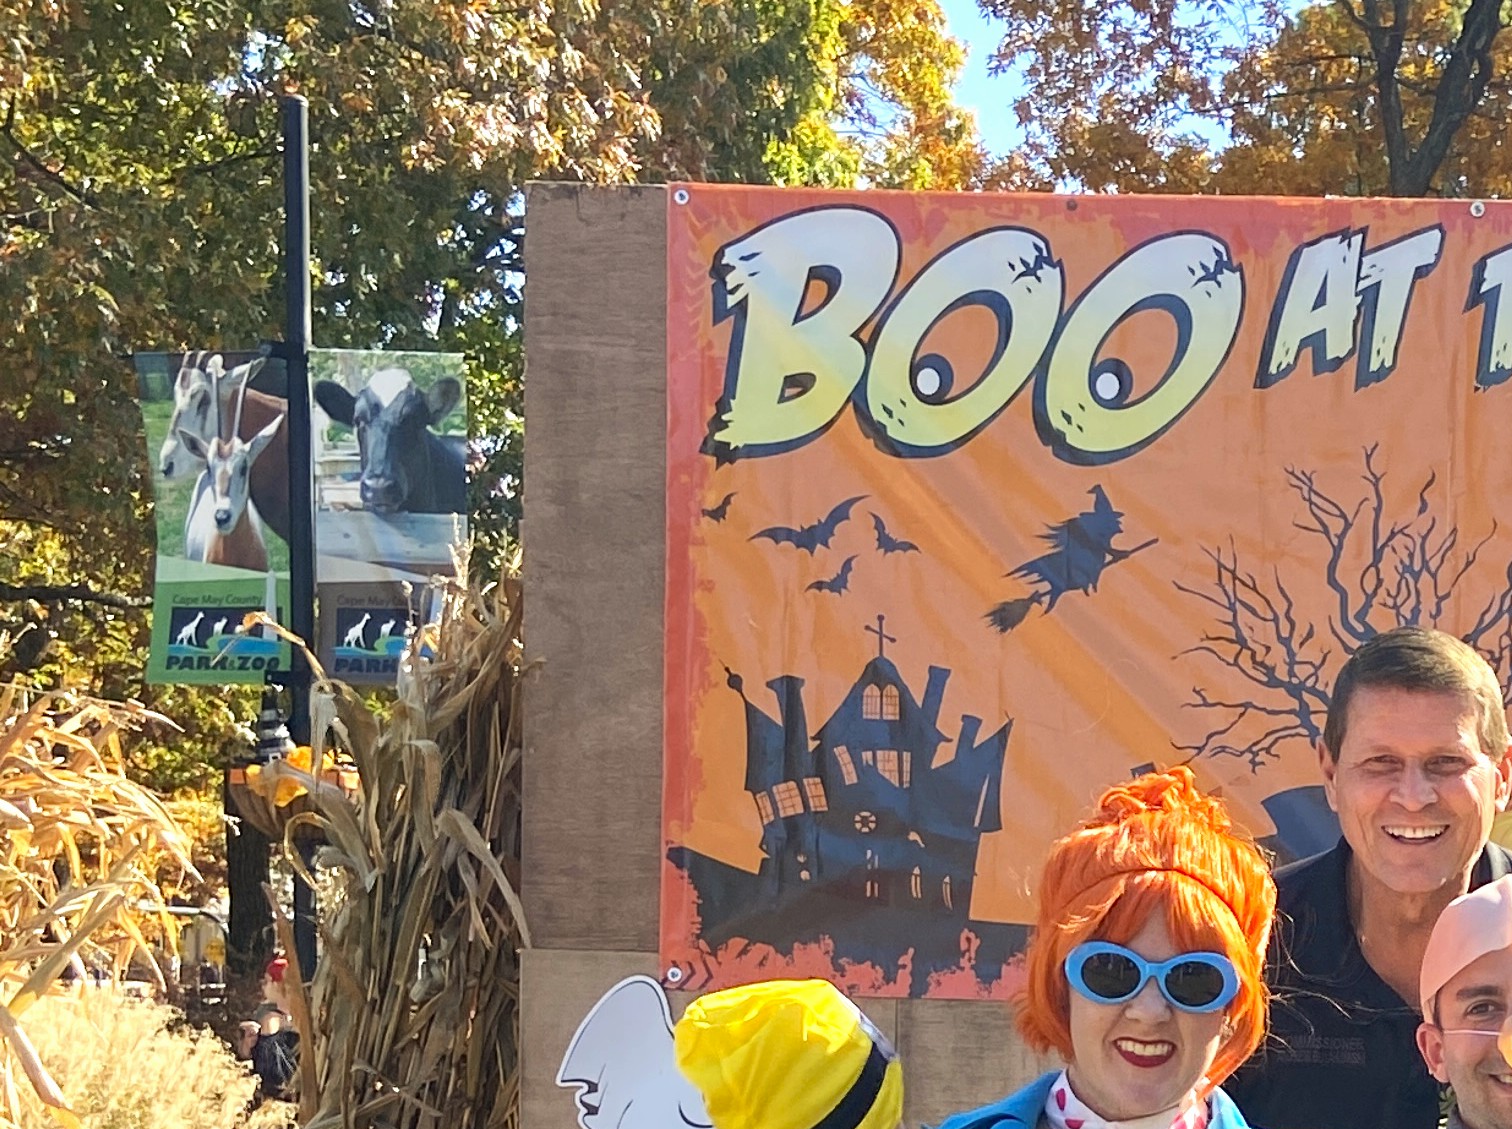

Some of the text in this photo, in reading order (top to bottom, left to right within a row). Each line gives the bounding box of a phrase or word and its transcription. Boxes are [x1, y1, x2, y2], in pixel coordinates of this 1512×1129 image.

[699, 204, 1246, 467] BOO
[1255, 224, 1444, 391] AT
[172, 594, 263, 607] Cape May County
[1280, 1034, 1366, 1051] OMMISSIONER
